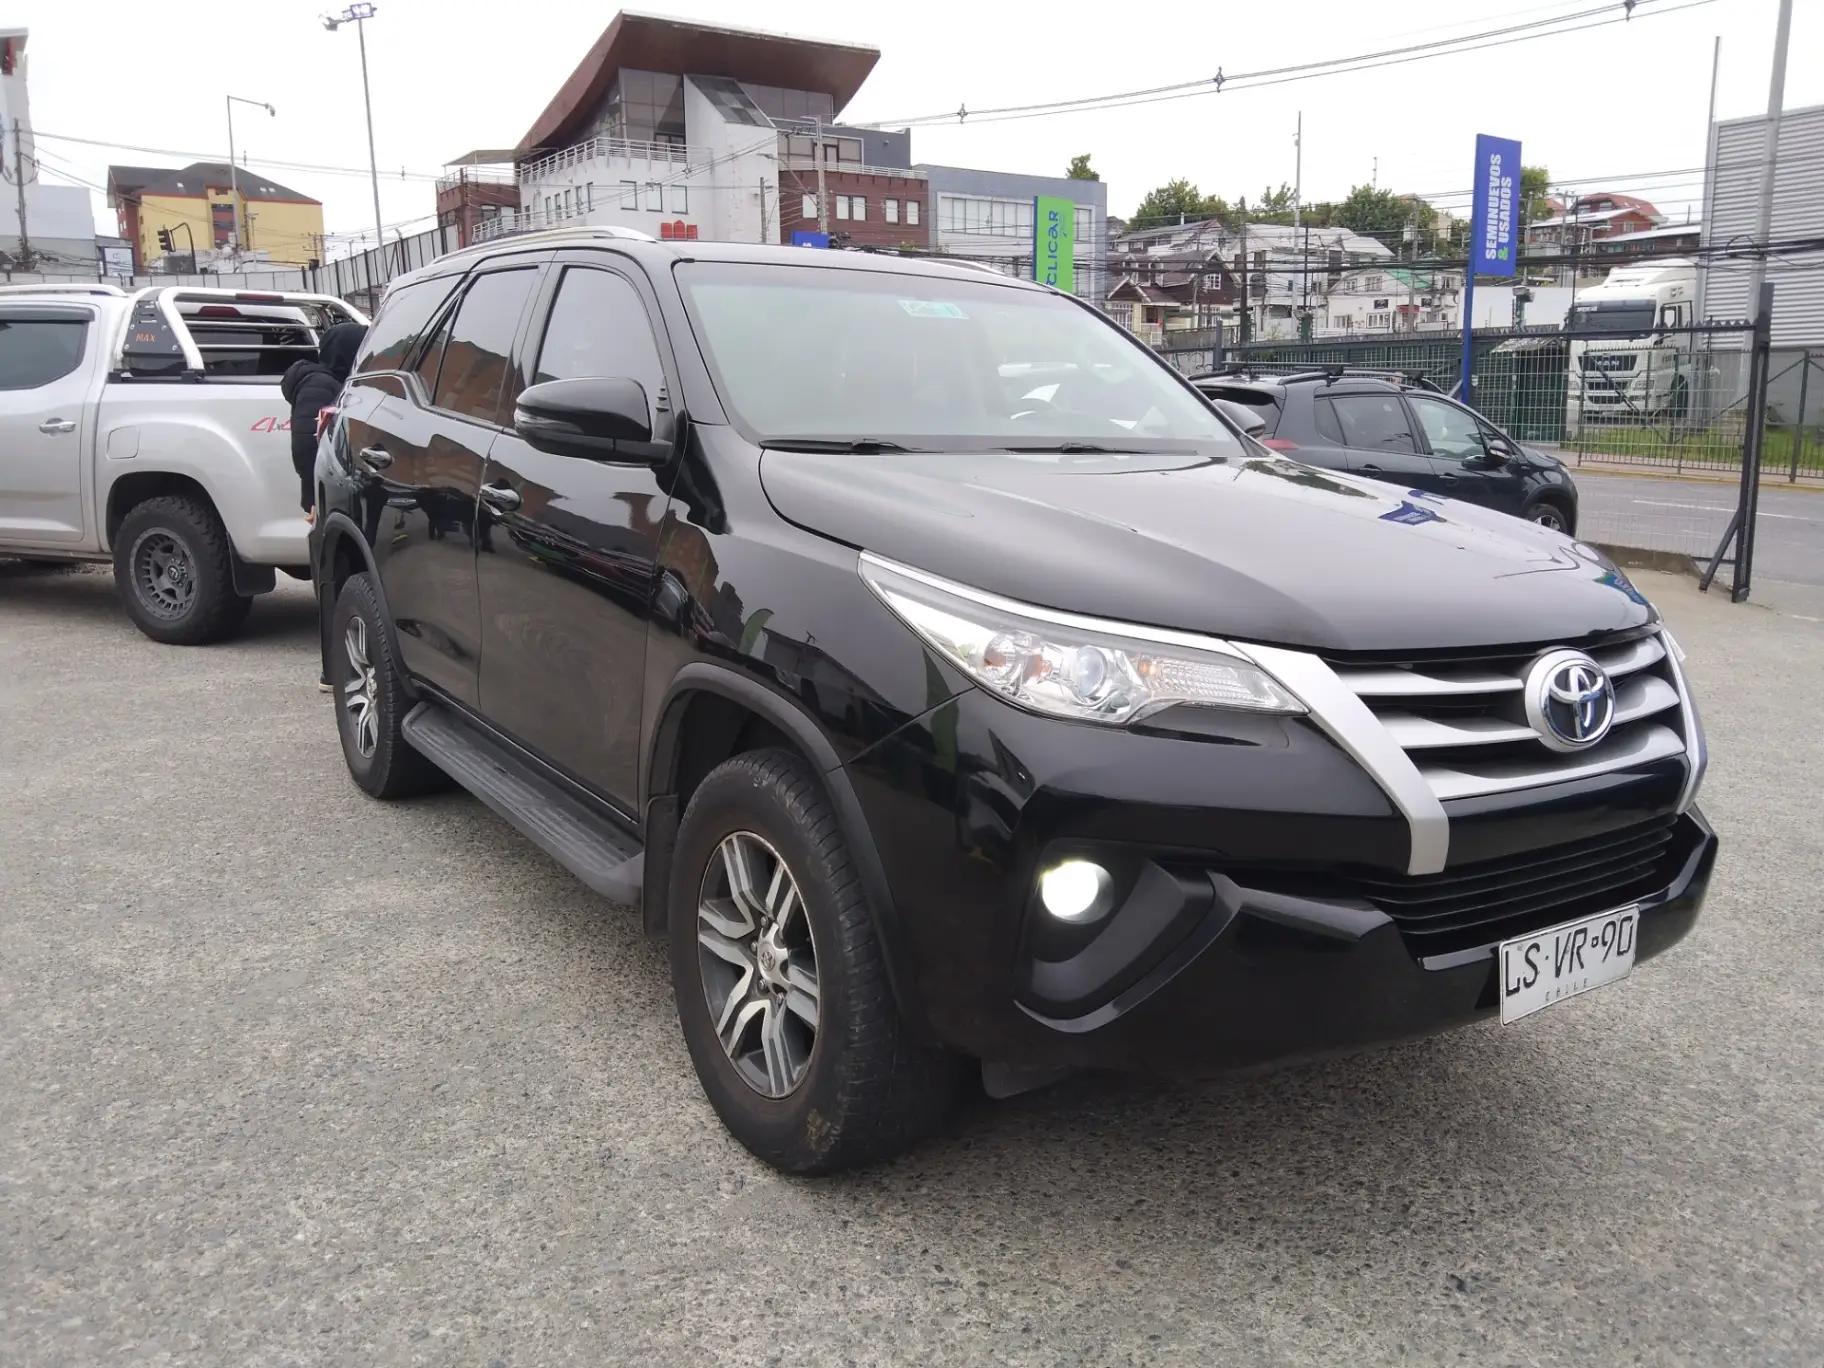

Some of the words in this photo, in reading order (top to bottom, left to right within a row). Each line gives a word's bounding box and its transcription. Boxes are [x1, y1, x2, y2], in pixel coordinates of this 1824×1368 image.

[1486, 154, 1501, 260] SEMINUEVOS
[1498, 176, 1512, 243] USADOS
[1498, 246, 1509, 261] &
